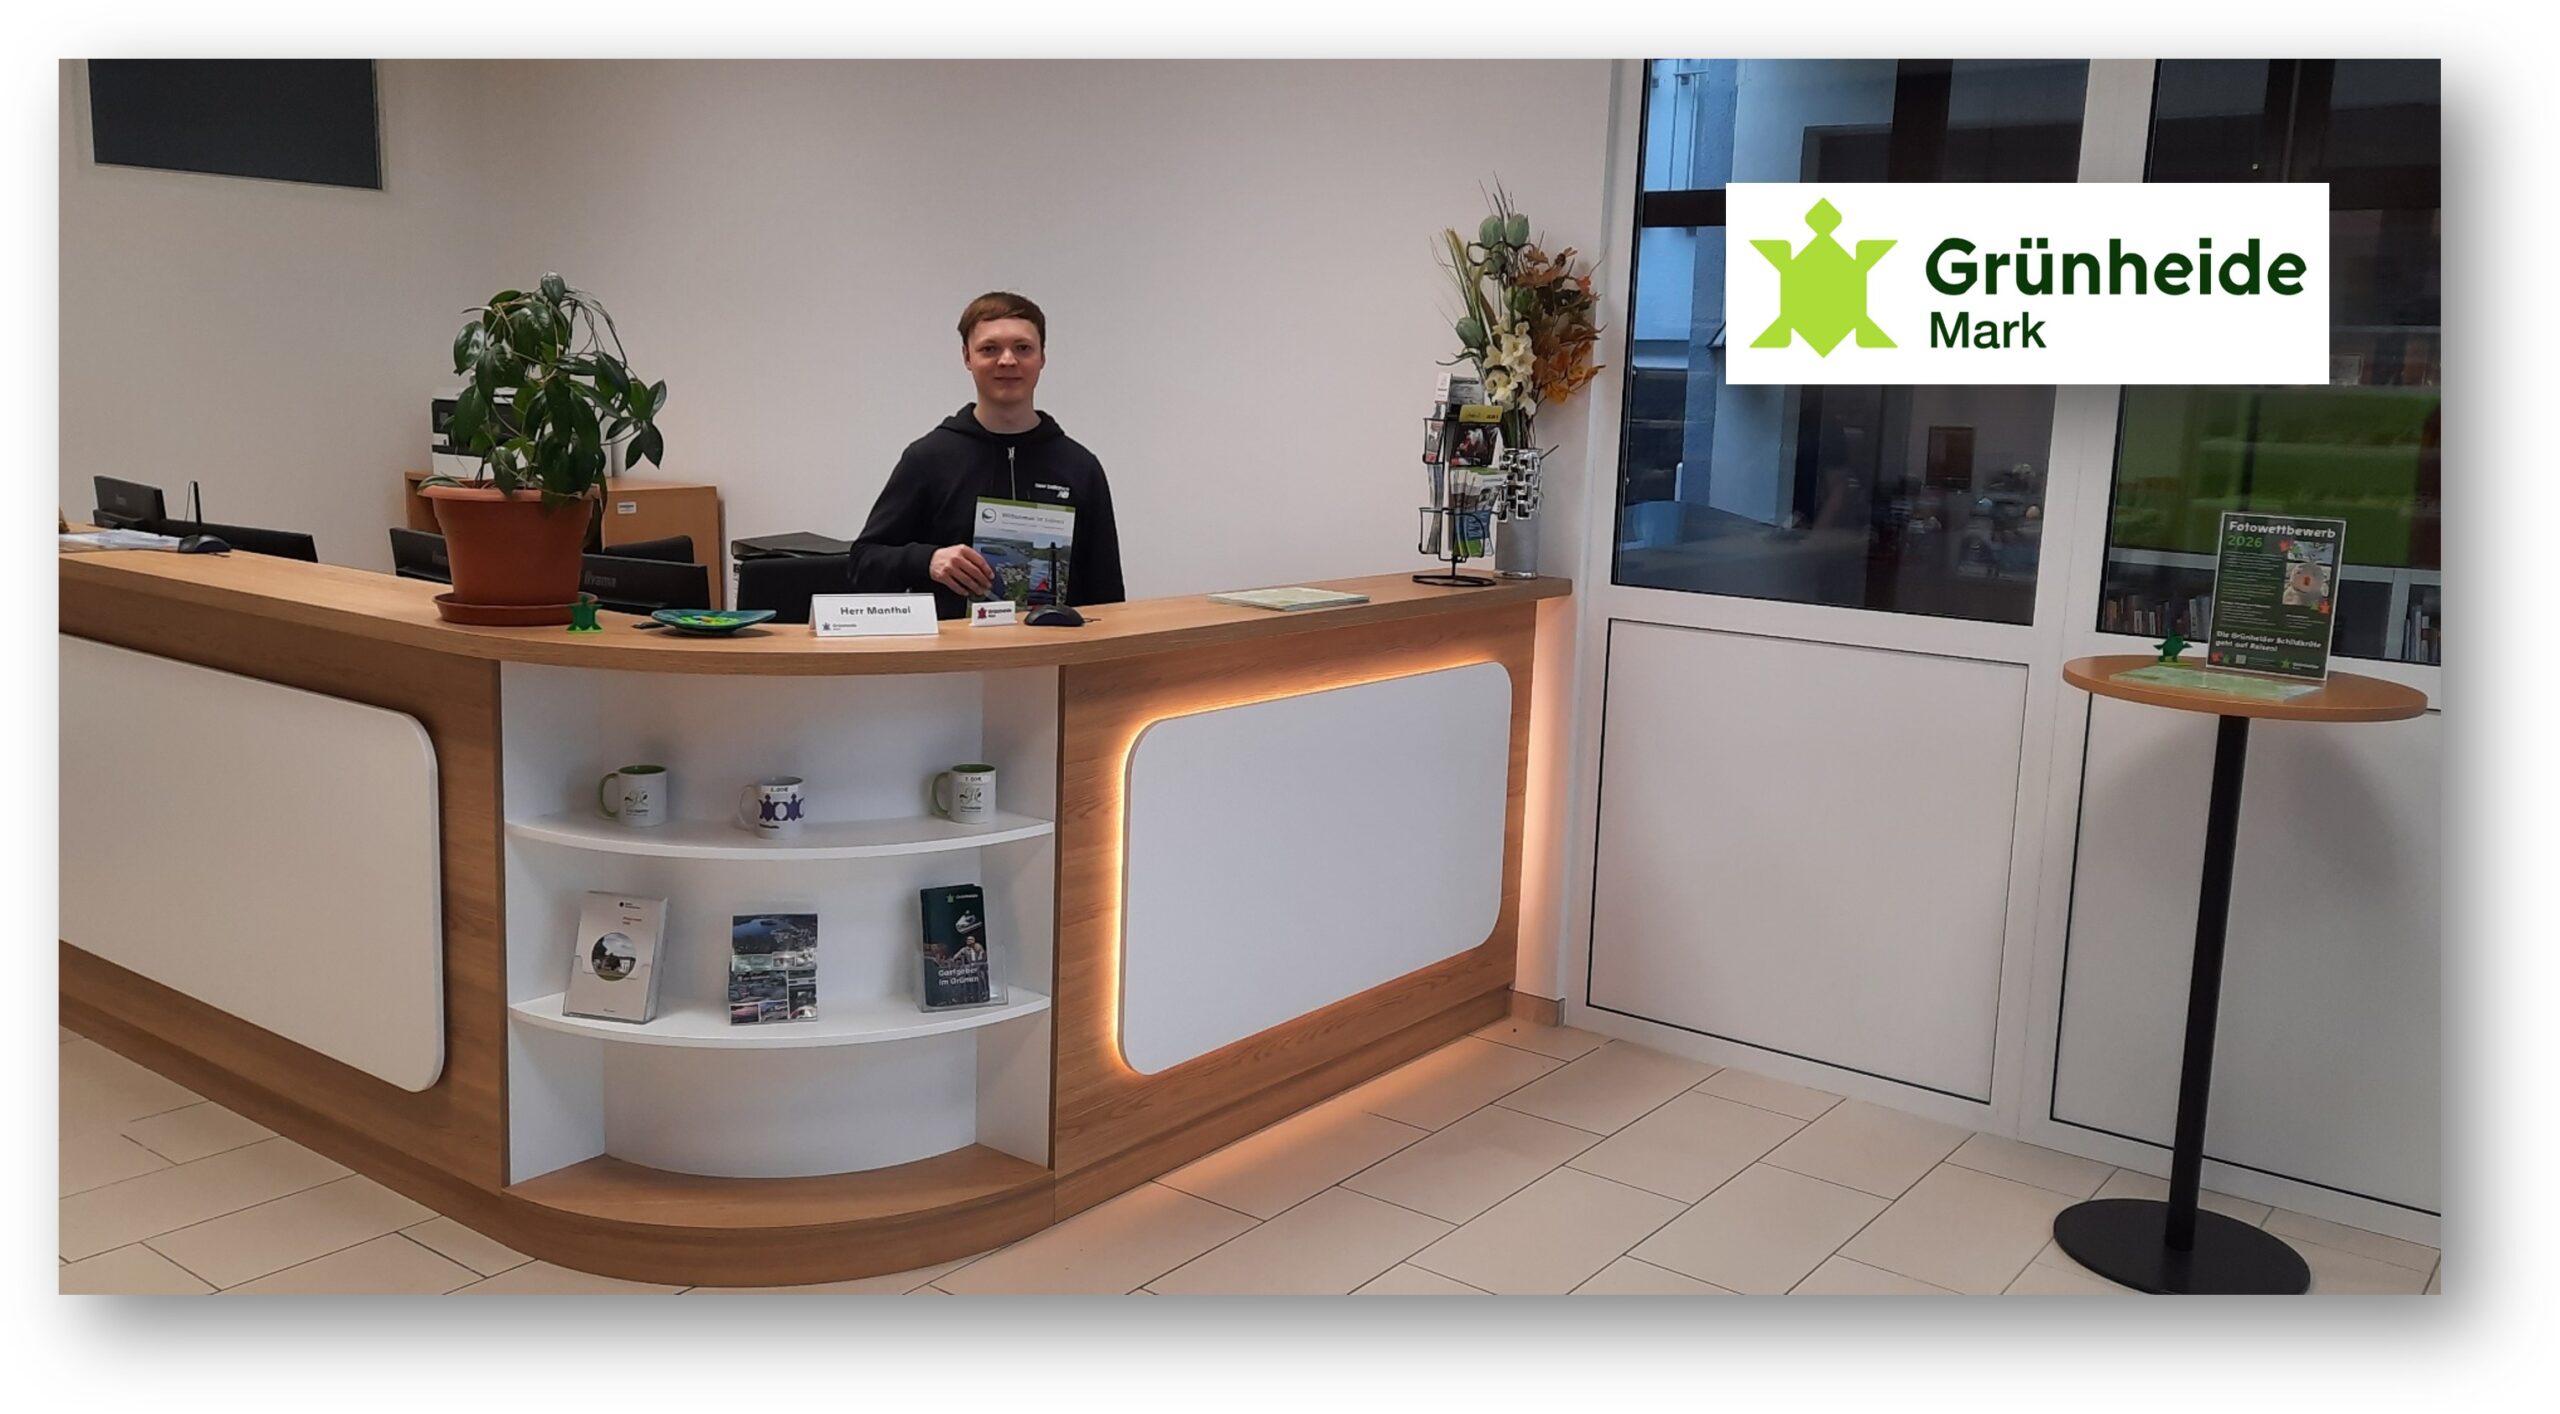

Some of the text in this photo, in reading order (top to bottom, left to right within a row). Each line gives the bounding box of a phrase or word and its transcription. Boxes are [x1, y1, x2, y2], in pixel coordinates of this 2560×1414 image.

[2228, 520, 2336, 539] Fotowettbewerb
[2227, 534, 2264, 548] 2026
[839, 606, 865, 616] Herr
